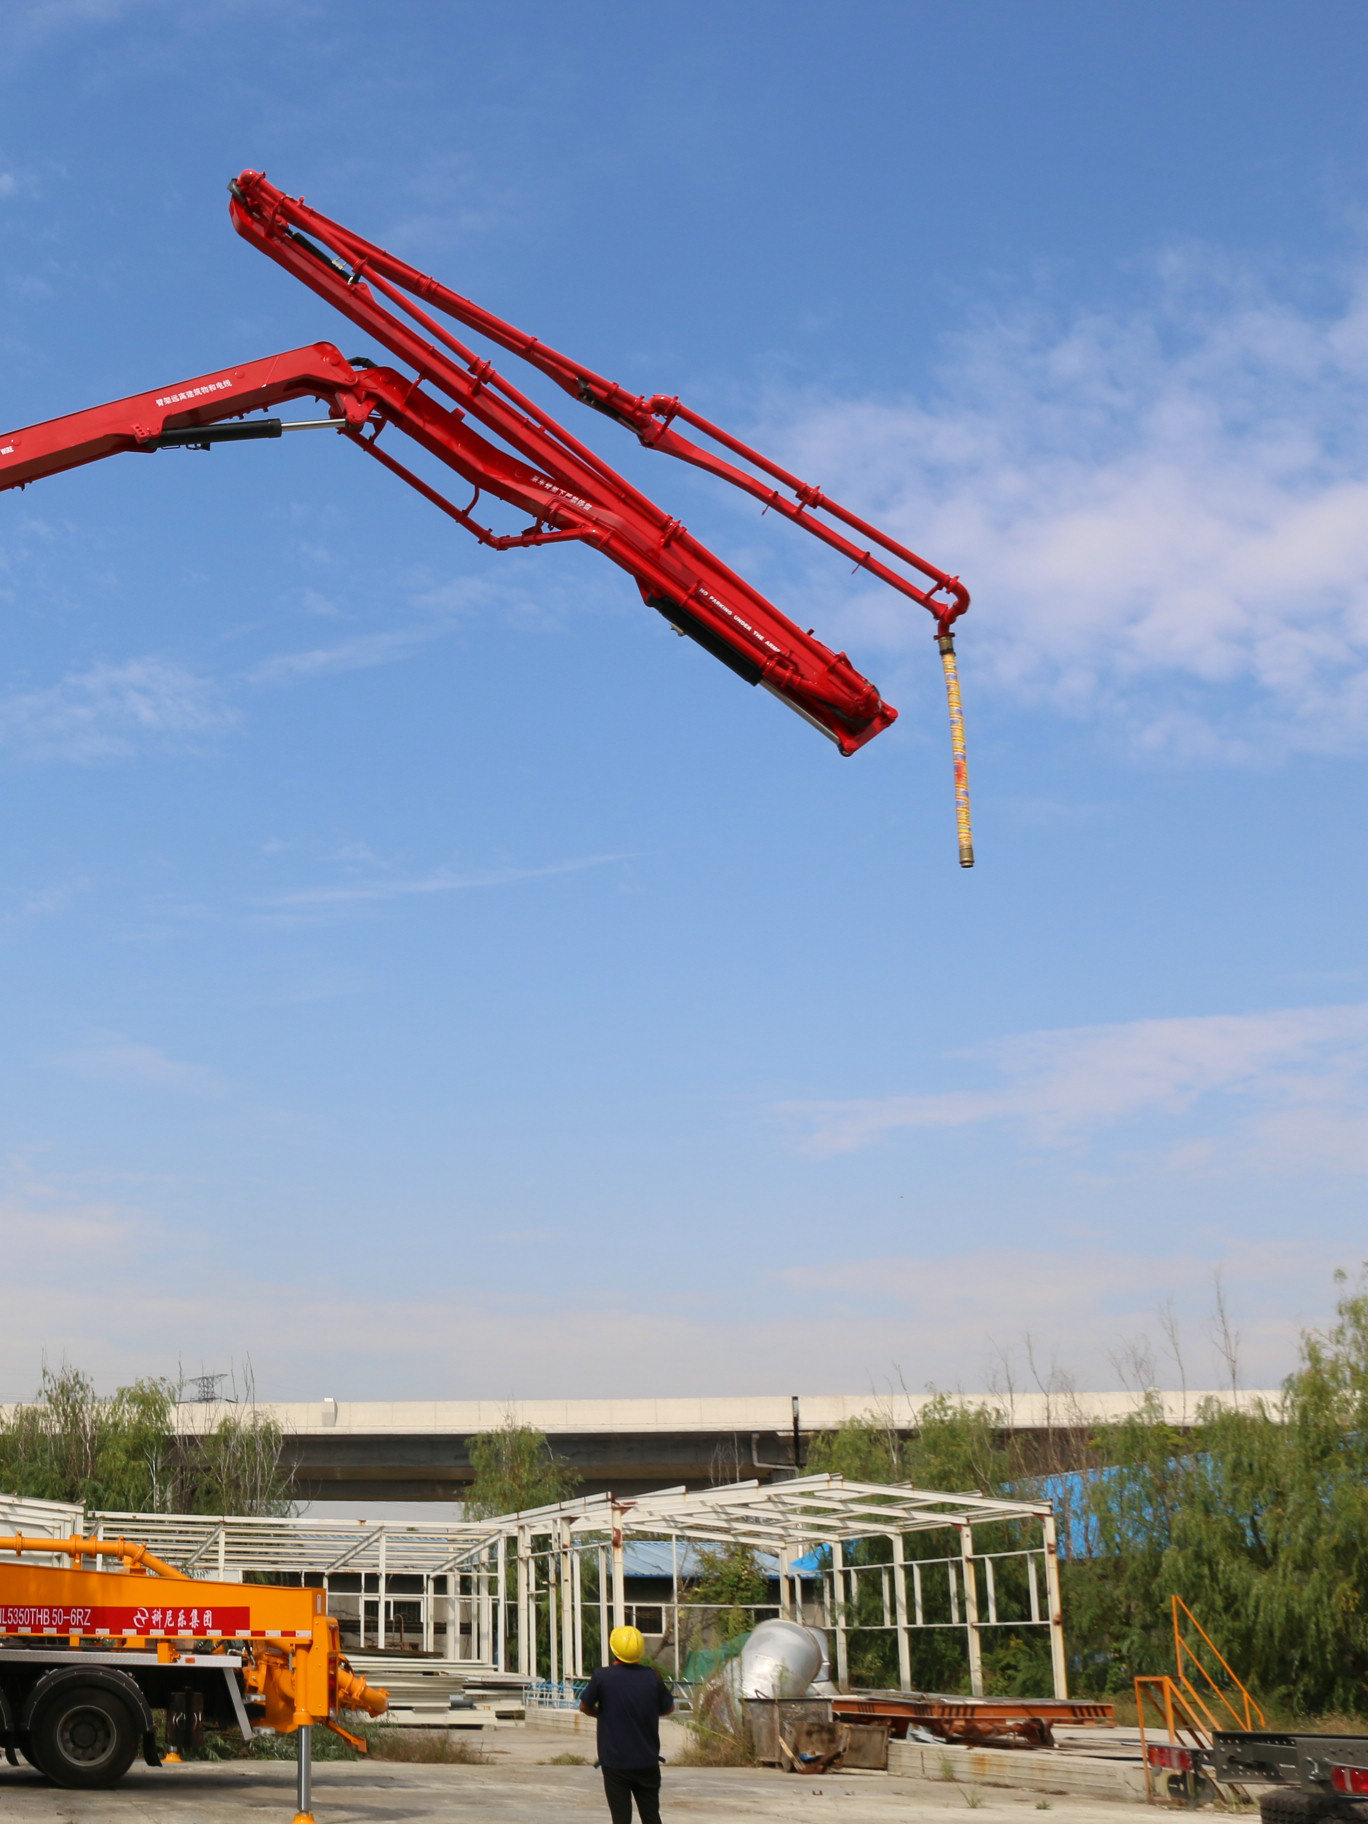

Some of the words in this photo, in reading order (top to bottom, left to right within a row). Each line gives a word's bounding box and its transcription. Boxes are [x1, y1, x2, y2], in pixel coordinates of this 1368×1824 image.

[0, 445, 14, 455] WIRE
[699, 588, 709, 596] NO
[709, 595, 733, 616] PARKING
[733, 615, 752, 632] UNDER
[753, 630, 765, 641] THE
[51, 1608, 92, 1626] 50-6RZ
[151, 1608, 213, 1629] 科尼乐集团
